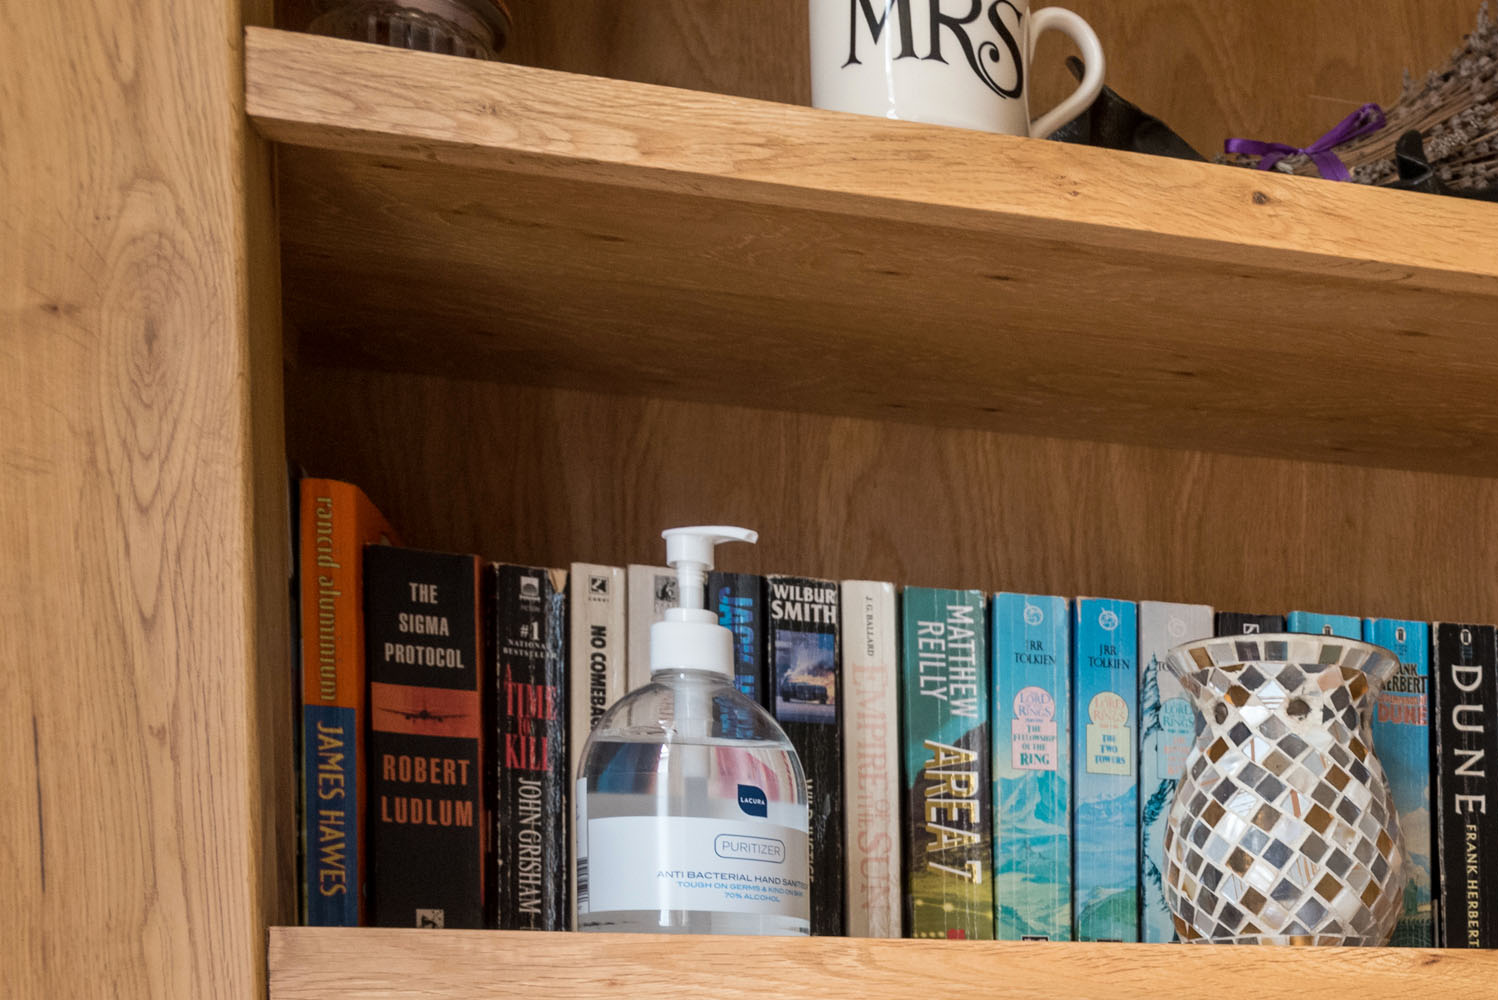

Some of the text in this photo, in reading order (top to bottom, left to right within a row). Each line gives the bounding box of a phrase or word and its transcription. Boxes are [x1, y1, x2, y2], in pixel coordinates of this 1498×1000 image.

[843, 0, 1023, 101] MRS
[409, 583, 438, 604] THE
[773, 585, 836, 605] WILBUR
[398, 613, 449, 637] SIGMA
[772, 602, 837, 624] SMITH
[384, 642, 464, 669] PROTOCOL
[918, 621, 947, 701] REILLY
[947, 605, 978, 718] MATTHEW
[1015, 653, 1056, 664] TOLKIEN
[1088, 657, 1130, 670] TOLKIEN
[382, 755, 470, 785] ROBERT
[1020, 753, 1050, 765] RING
[317, 722, 346, 897] JAMES HAWES
[381, 796, 473, 827] LUDLUM
[740, 797, 765, 805] LACURA
[924, 740, 982, 884] AREA 7
[1451, 664, 1486, 949] DUNE FRANK HERBERT
[518, 777, 541, 914] JOHN GRISHAM
[722, 840, 781, 856] PURITIZER
[687, 872, 752, 882] BACTERIAL
[755, 876, 781, 885] HAND
[744, 893, 780, 902] ALCOHOL
